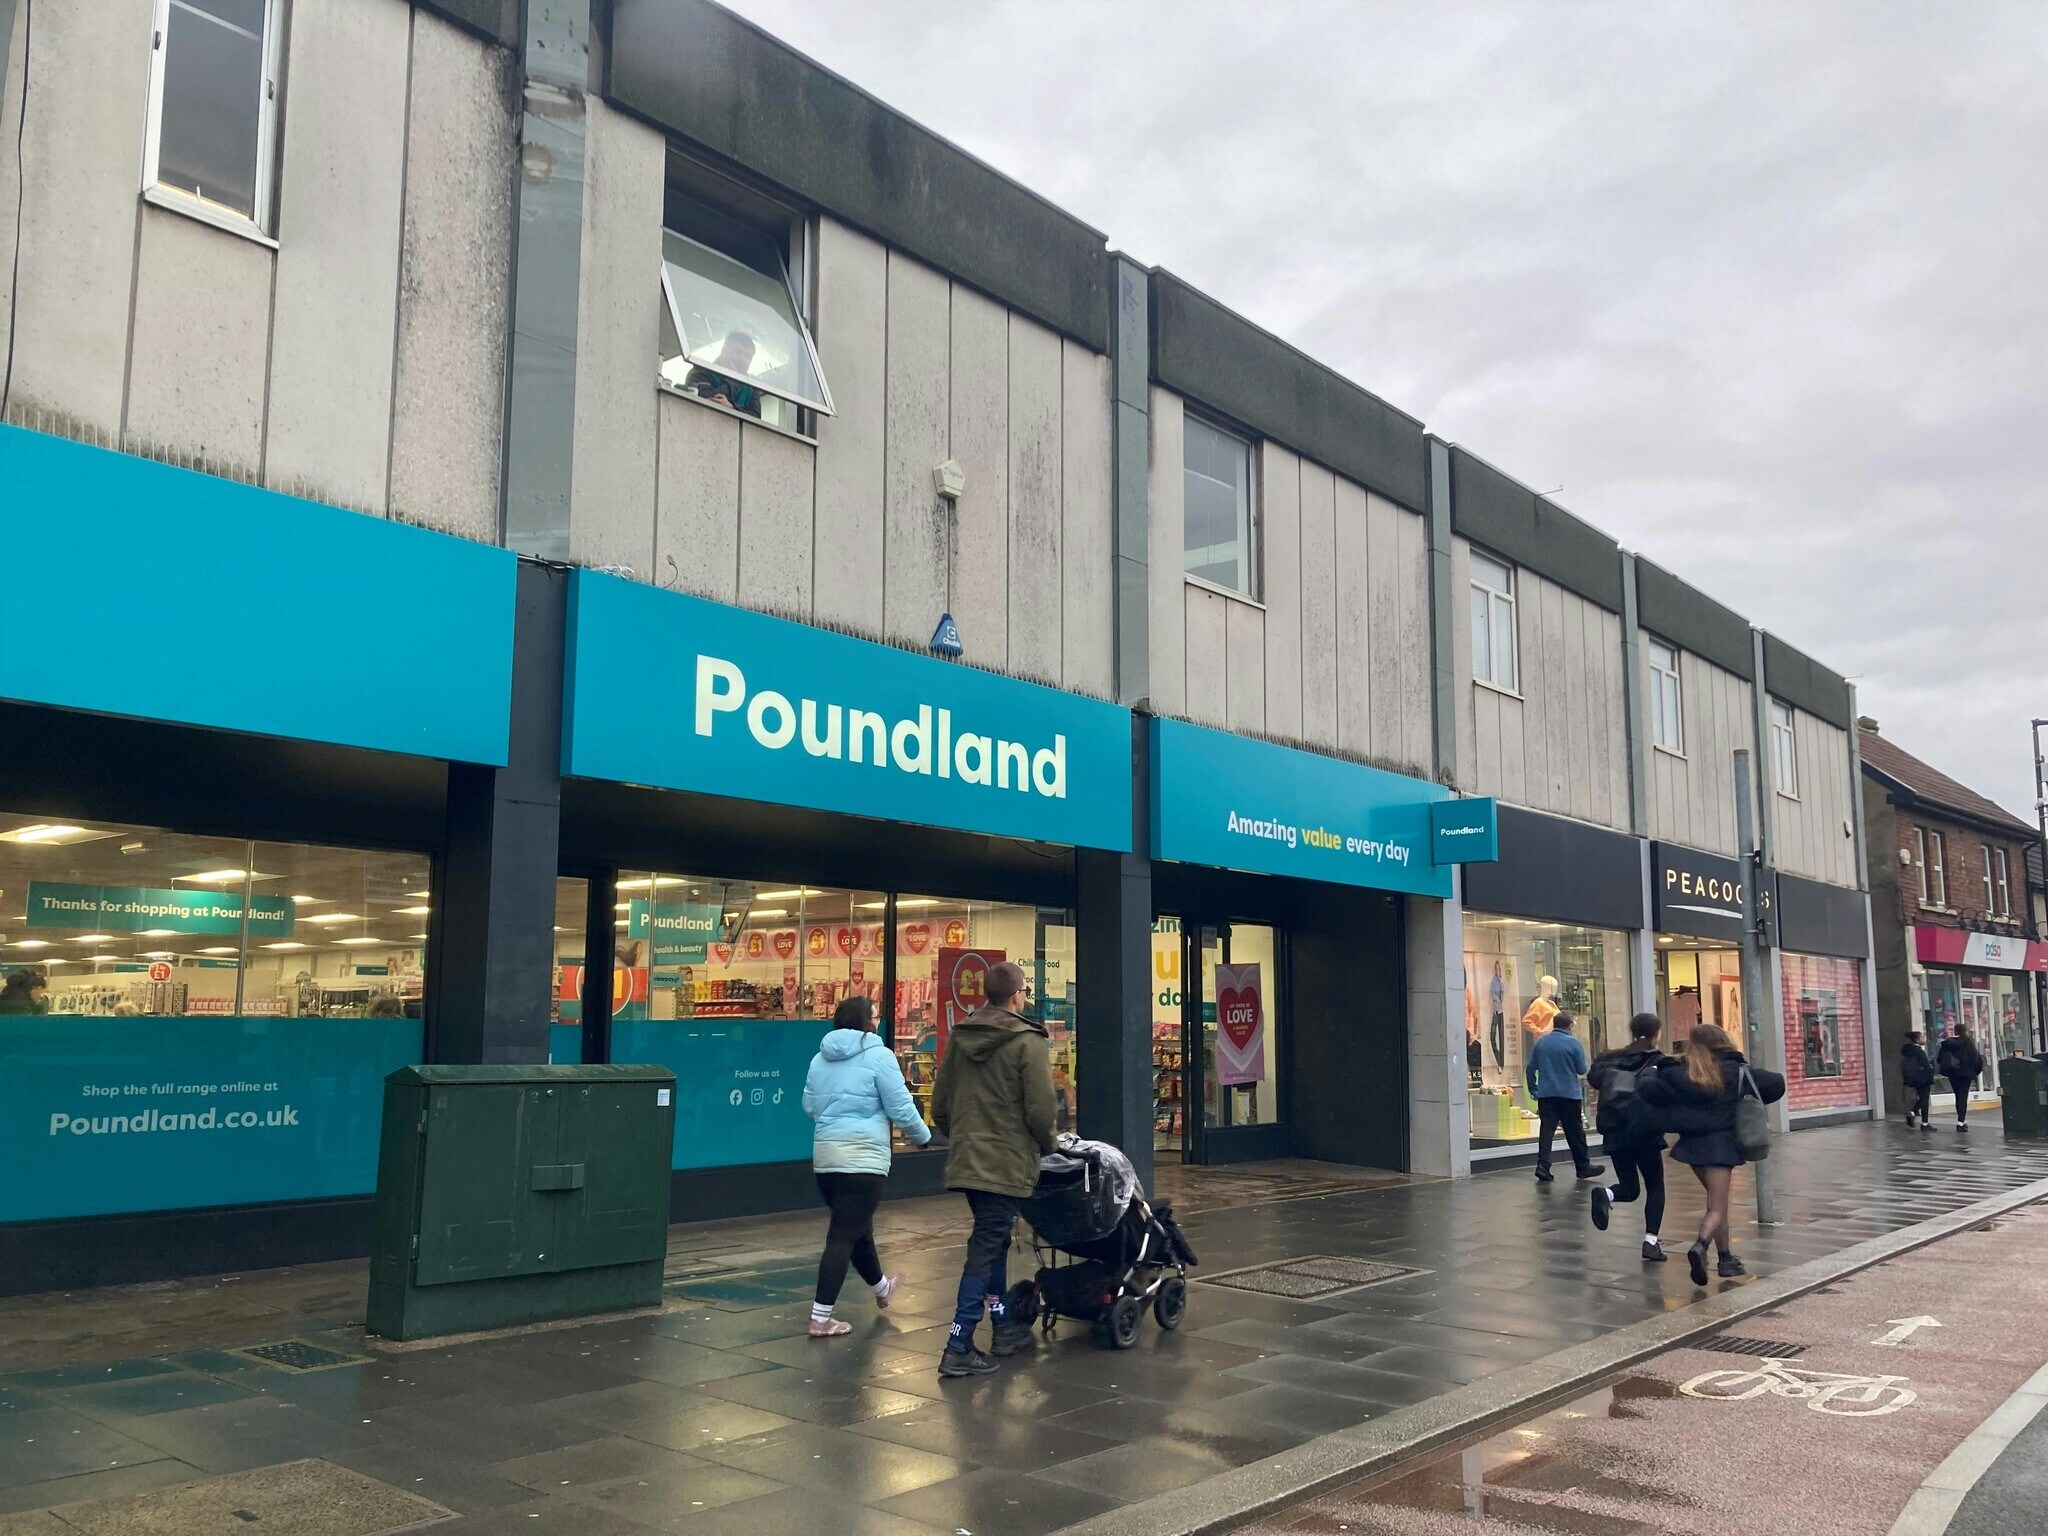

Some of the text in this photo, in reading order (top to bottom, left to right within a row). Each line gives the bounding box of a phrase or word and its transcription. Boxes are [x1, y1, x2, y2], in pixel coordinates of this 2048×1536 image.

[695, 654, 1067, 799] Poundland
[1227, 811, 1410, 867] Amazing value every day
[1440, 825, 1485, 836] Poundland
[42, 897, 97, 911] Thanks
[101, 901, 122, 912] for
[125, 902, 190, 918] shopping
[193, 907, 209, 916] at
[654, 945, 673, 953] health
[681, 944, 702, 953] beauty
[777, 940, 792, 948] LOVE
[1986, 941, 2001, 959] pdsa
[960, 969, 985, 995] £1
[1227, 1009, 1253, 1024] LOVE
[734, 1070, 760, 1078] Follow
[82, 1081, 279, 1098] Shop the full range online at
[50, 1104, 299, 1136] Poundland.co.uk
